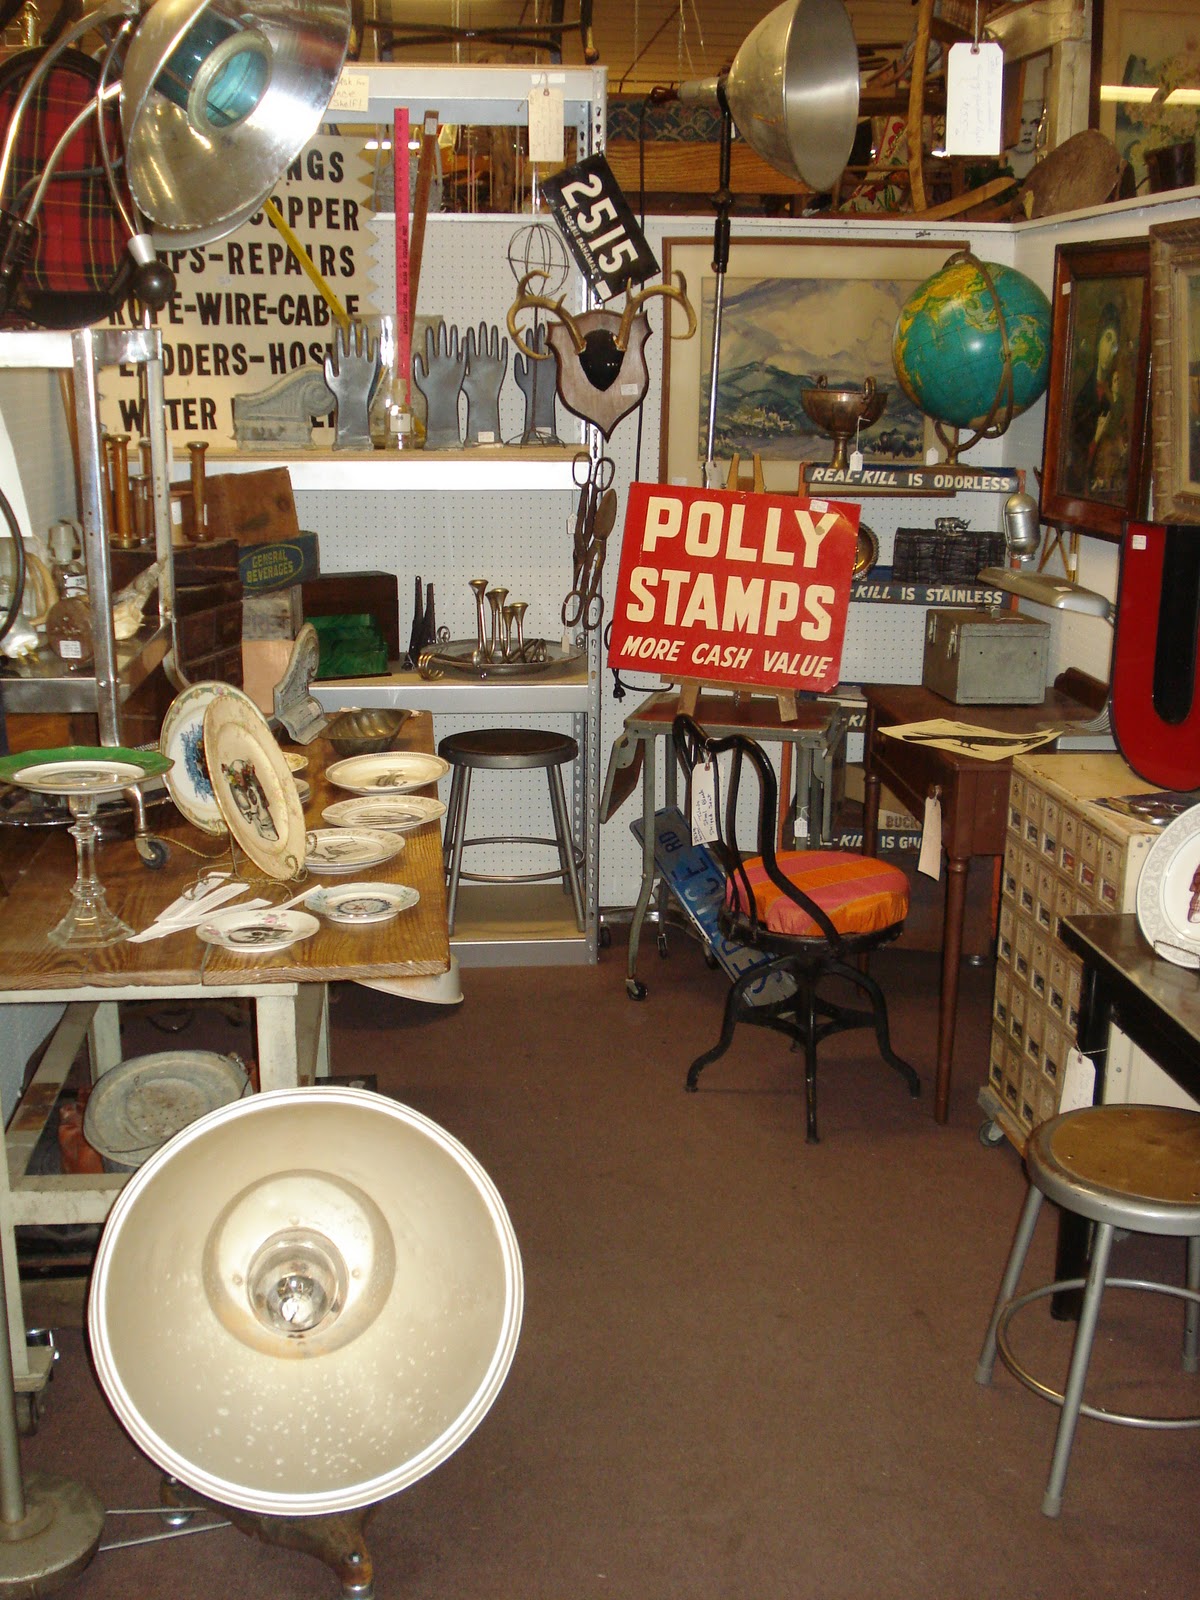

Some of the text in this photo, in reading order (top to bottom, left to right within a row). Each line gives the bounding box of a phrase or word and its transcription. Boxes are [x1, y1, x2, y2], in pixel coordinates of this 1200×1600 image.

[280, 149, 344, 183] NGS
[560, 205, 599, 275] NASSAU BAHAMAS
[561, 173, 639, 273] 2515
[109, 292, 361, 326] OE-WIRE-CABE
[119, 341, 333, 377] DDERS-HOS
[118, 397, 217, 432] WTER
[812, 467, 1010, 490] REAL-KILL IS ODORLESS
[642, 496, 841, 569] POLLY
[246, 560, 294, 583] BEVERAGES
[252, 549, 288, 568] GENERAL
[626, 566, 836, 642] STAMPS
[901, 586, 915, 600] IS
[926, 588, 1003, 604] STAINLESS
[620, 635, 833, 679] MORE CASH VALUE
[659, 831, 683, 853] RD
[881, 835, 895, 849] IS
